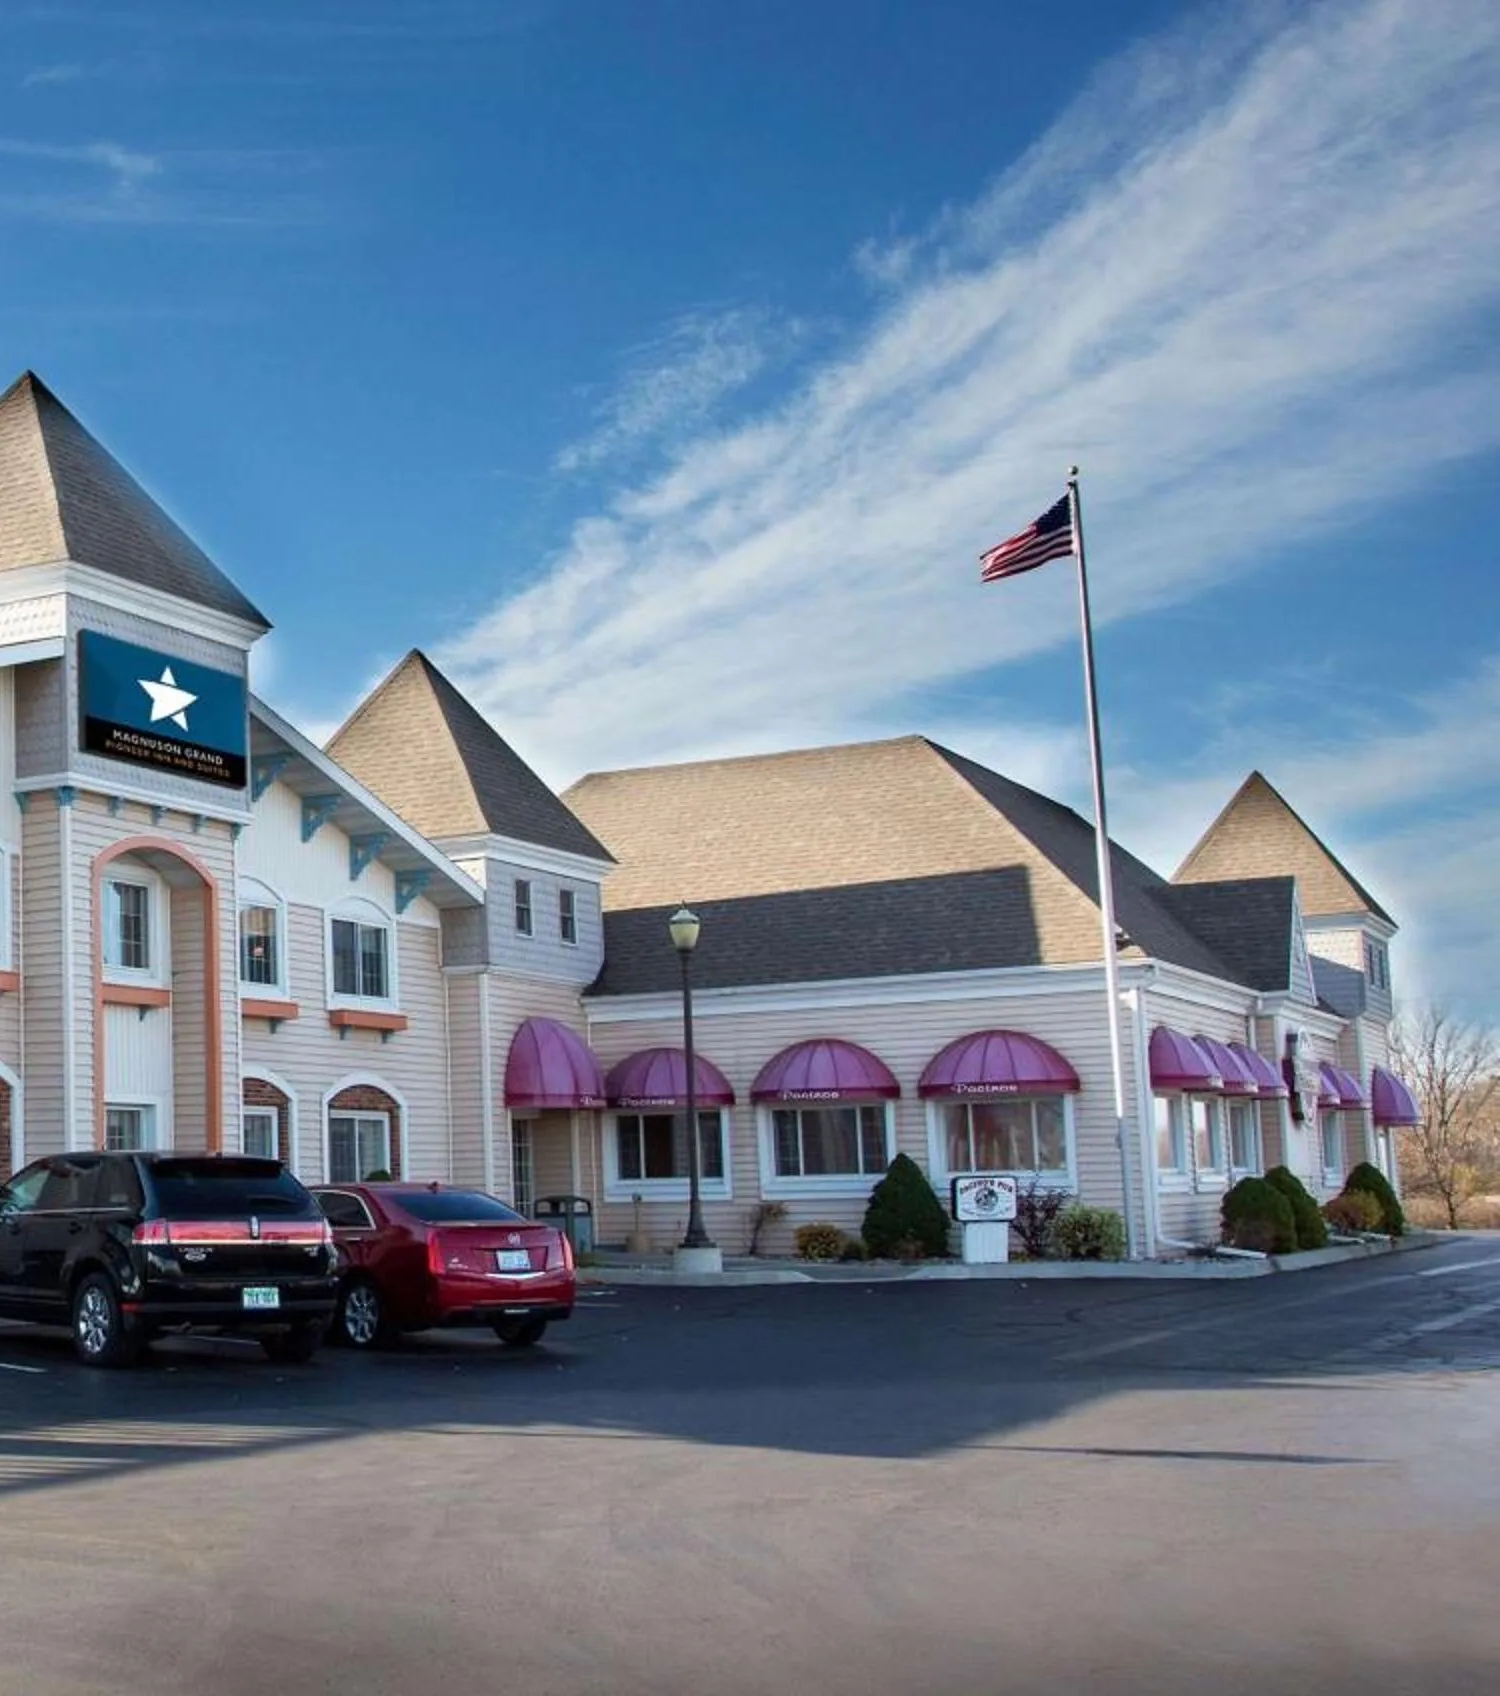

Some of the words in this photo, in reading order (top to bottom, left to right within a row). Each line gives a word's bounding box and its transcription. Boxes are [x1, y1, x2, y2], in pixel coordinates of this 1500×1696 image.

[112, 729, 182, 755] MAGNUSON
[183, 747, 224, 765] GRAND
[174, 756, 195, 769] AND
[197, 763, 231, 778] SUITES
